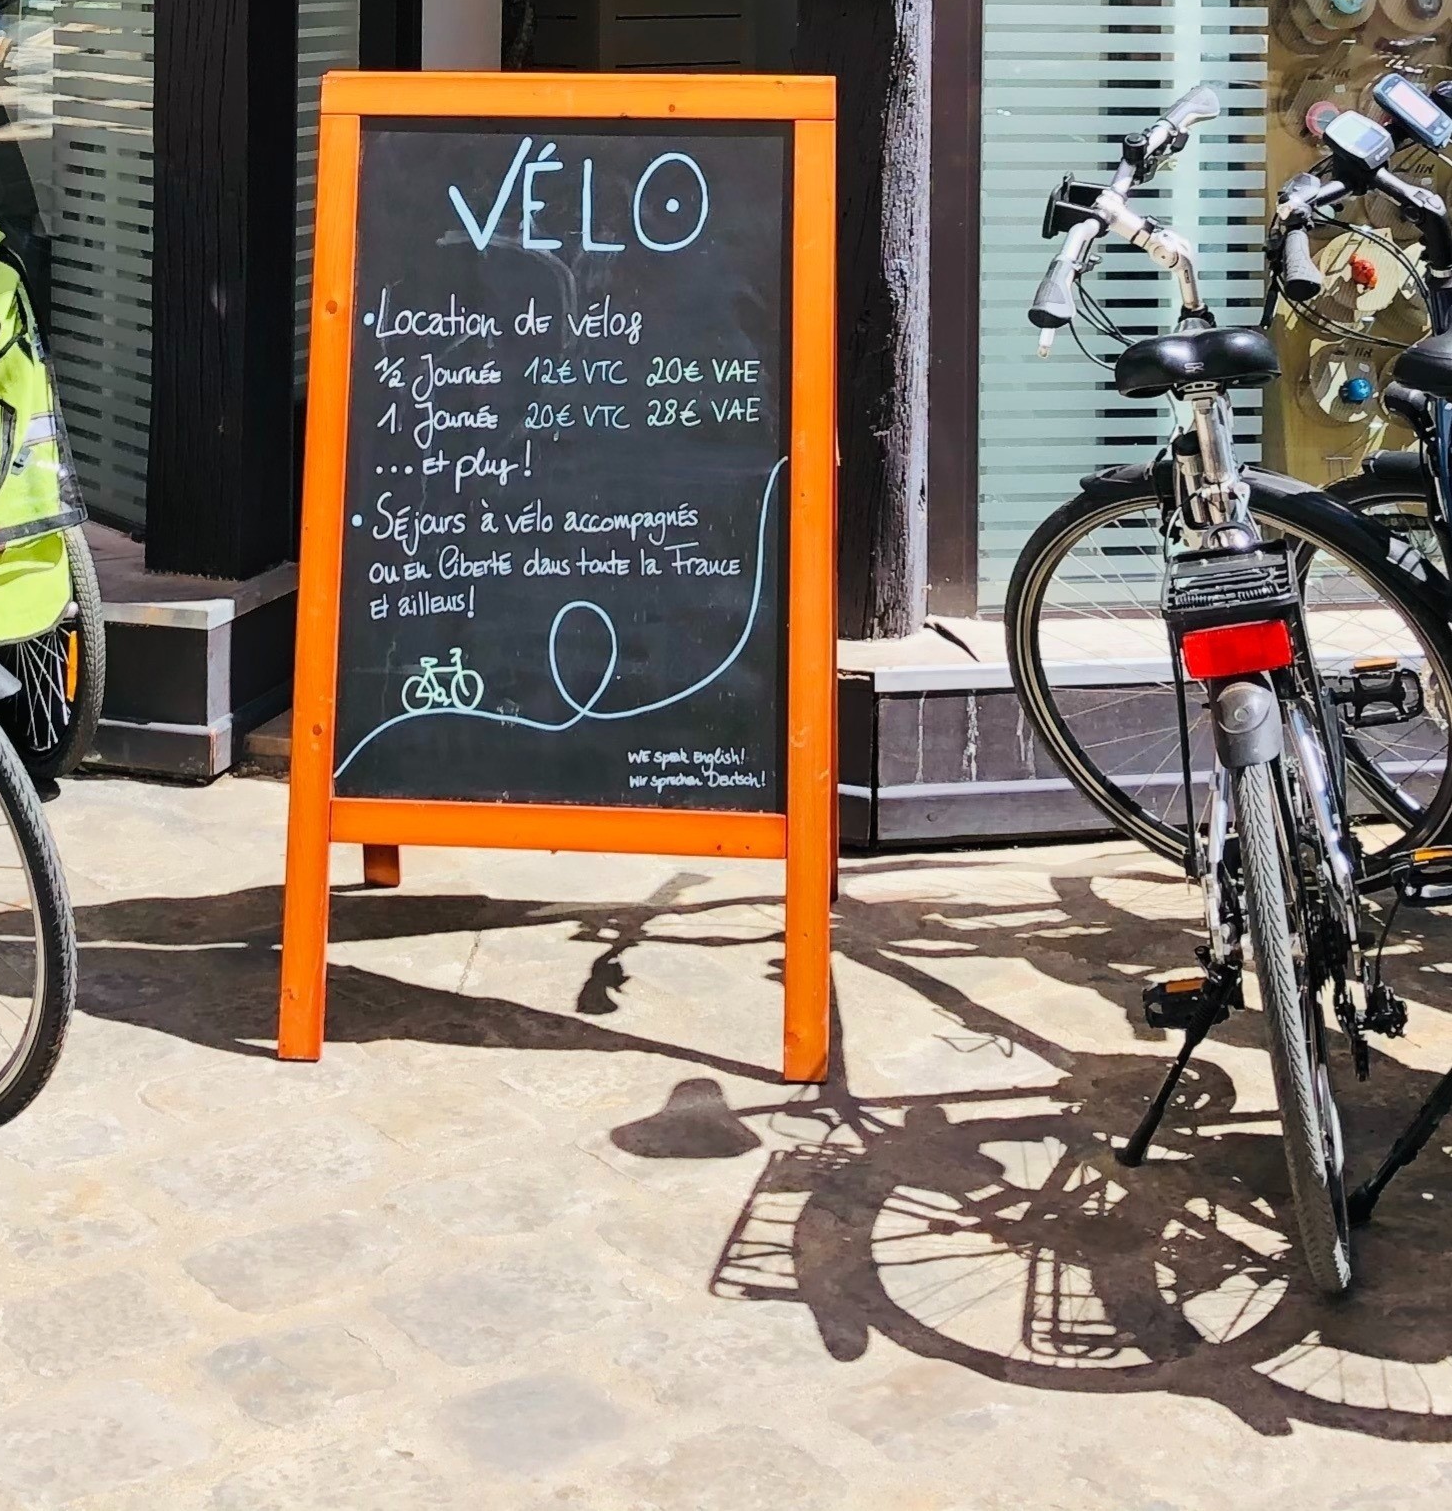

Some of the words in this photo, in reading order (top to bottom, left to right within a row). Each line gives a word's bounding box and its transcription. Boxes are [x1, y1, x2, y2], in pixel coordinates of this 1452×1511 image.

[449, 136, 709, 252] VÉLO
[375, 287, 502, 339] Location
[582, 359, 628, 385] VTC
[712, 358, 761, 384] VAE
[583, 404, 631, 430] VTC
[711, 397, 761, 423] VAE
[480, 498, 499, 533] à
[564, 502, 699, 546] accompagnés
[369, 562, 400, 584] ou
[523, 547, 571, 577] dans
[576, 547, 631, 576] toute
[640, 548, 663, 576] la
[664, 541, 741, 576] France
